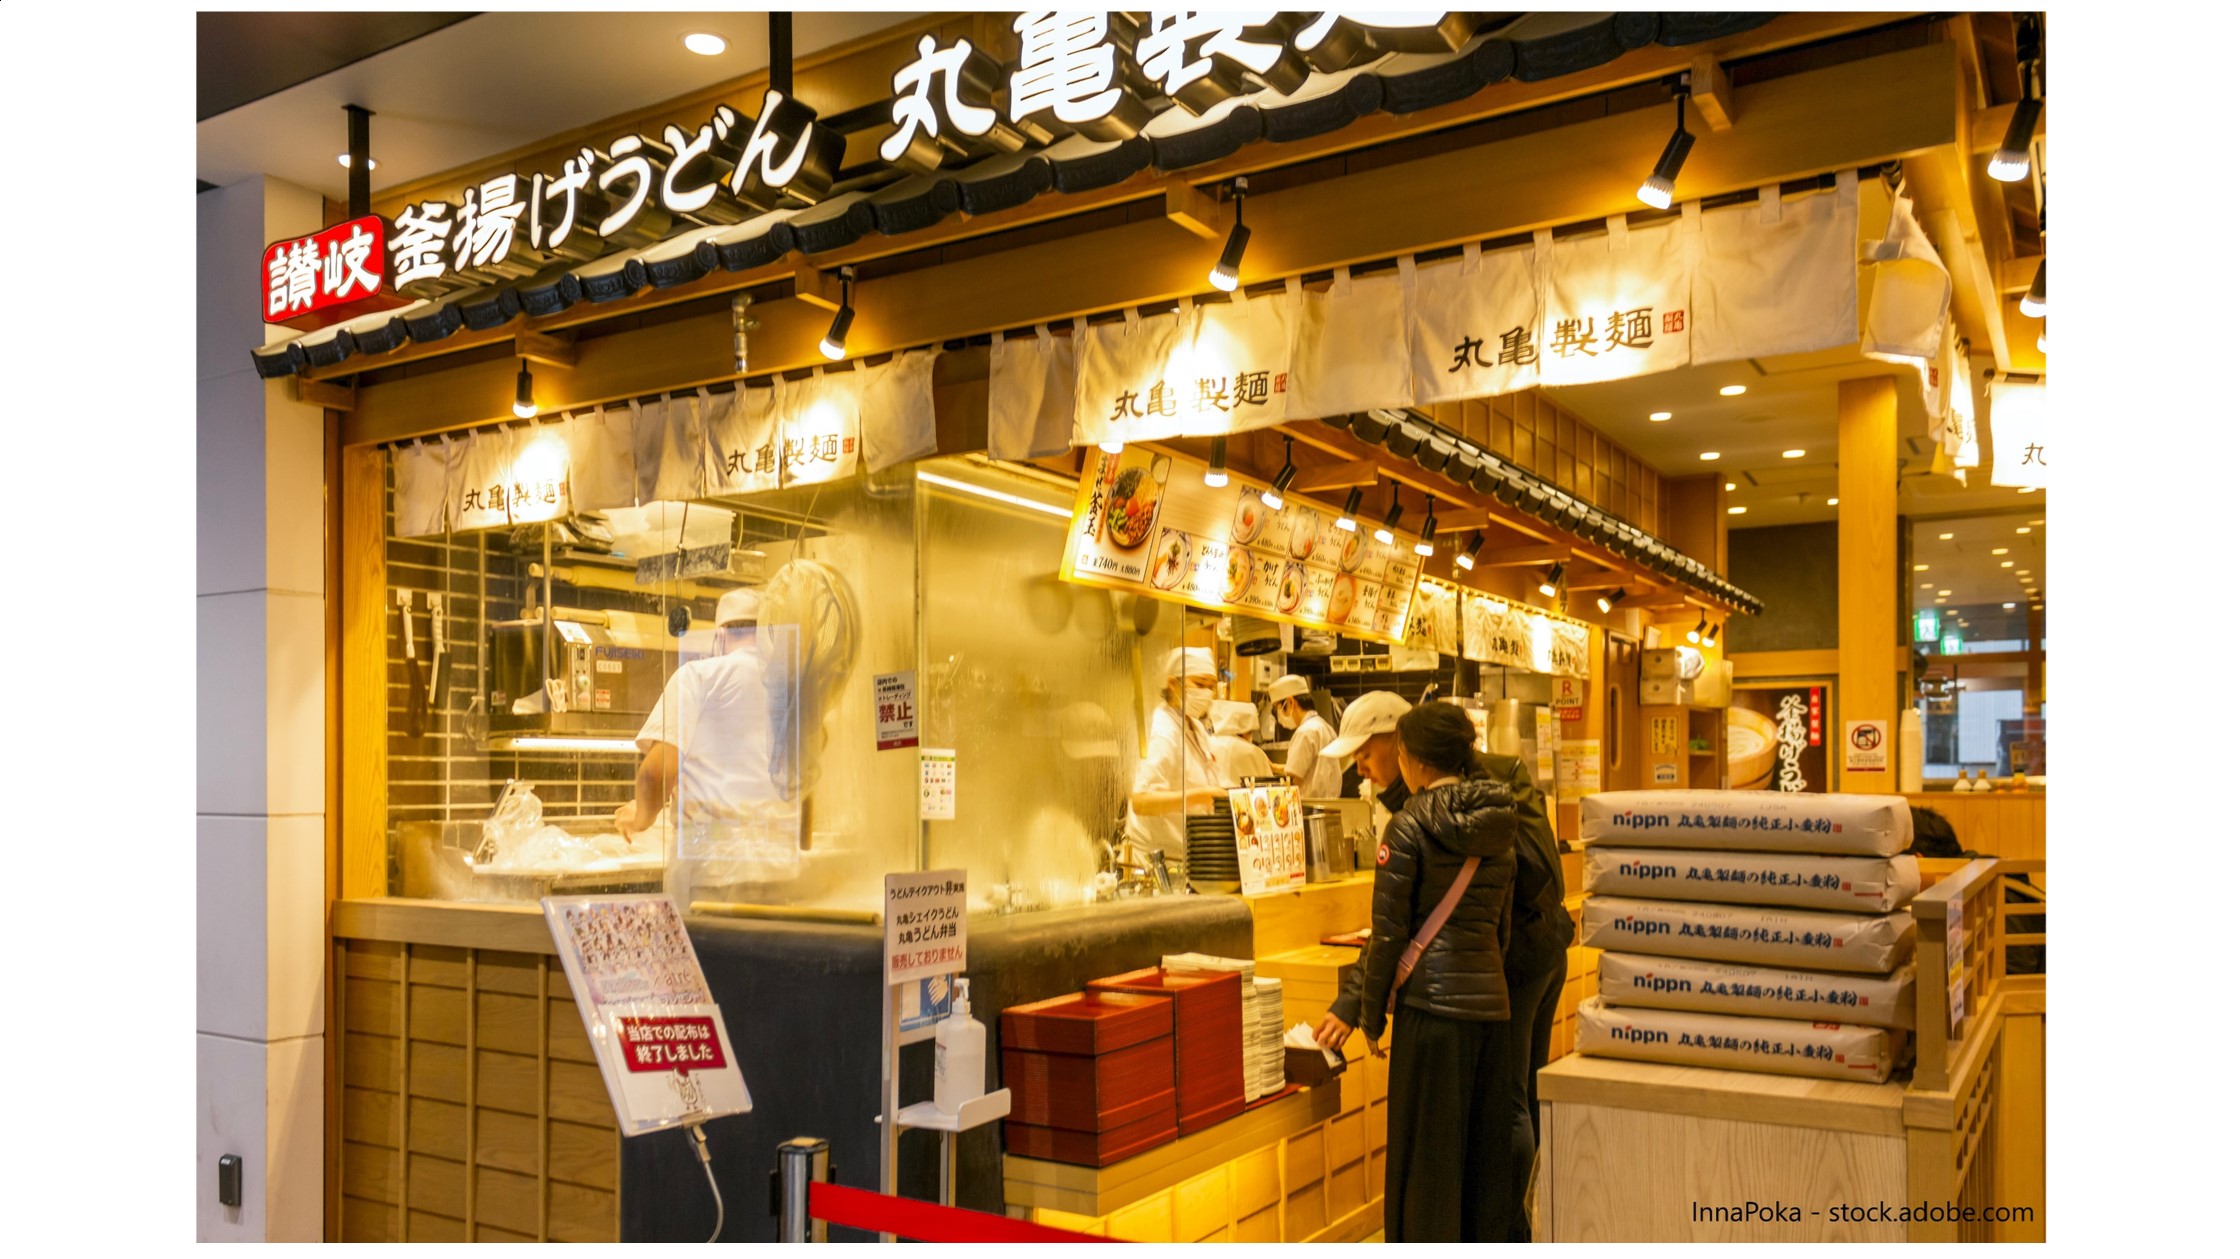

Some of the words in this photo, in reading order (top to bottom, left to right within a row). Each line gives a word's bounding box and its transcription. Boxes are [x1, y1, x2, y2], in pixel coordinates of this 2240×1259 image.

[268, 224, 381, 317] 讃岐
[388, 89, 813, 292] 釜揚げうどん
[1448, 307, 1654, 373] 丸亀製麺
[1110, 371, 1270, 421] 丸亀製麺
[727, 434, 838, 476] 丸亀製麺
[879, 701, 913, 723] 禁止
[1613, 810, 1669, 829] nippn
[1677, 814, 1831, 834] 丸亀製麺の純正小麦粉
[1620, 860, 1676, 880] nippn
[1685, 866, 1840, 890] 丸亀製麺の純正小麦粉
[896, 906, 959, 926] 丸亀シェイクうどん
[898, 922, 957, 945] 丸亀うどん弁当
[1614, 915, 1670, 935] nippn
[1678, 923, 1832, 948] 丸亀製麺の純正小麦粉
[891, 945, 963, 969] 販売しておりません
[1633, 972, 1691, 993] nippn
[1700, 980, 1857, 1007] 丸亀製麺の純正小麦粉
[627, 1024, 711, 1042] 当店での配布は
[1611, 1025, 1668, 1044] nippn
[1678, 1032, 1833, 1061] 丸亀製麺の純正小麦粉
[635, 1044, 714, 1064] 終了しました
